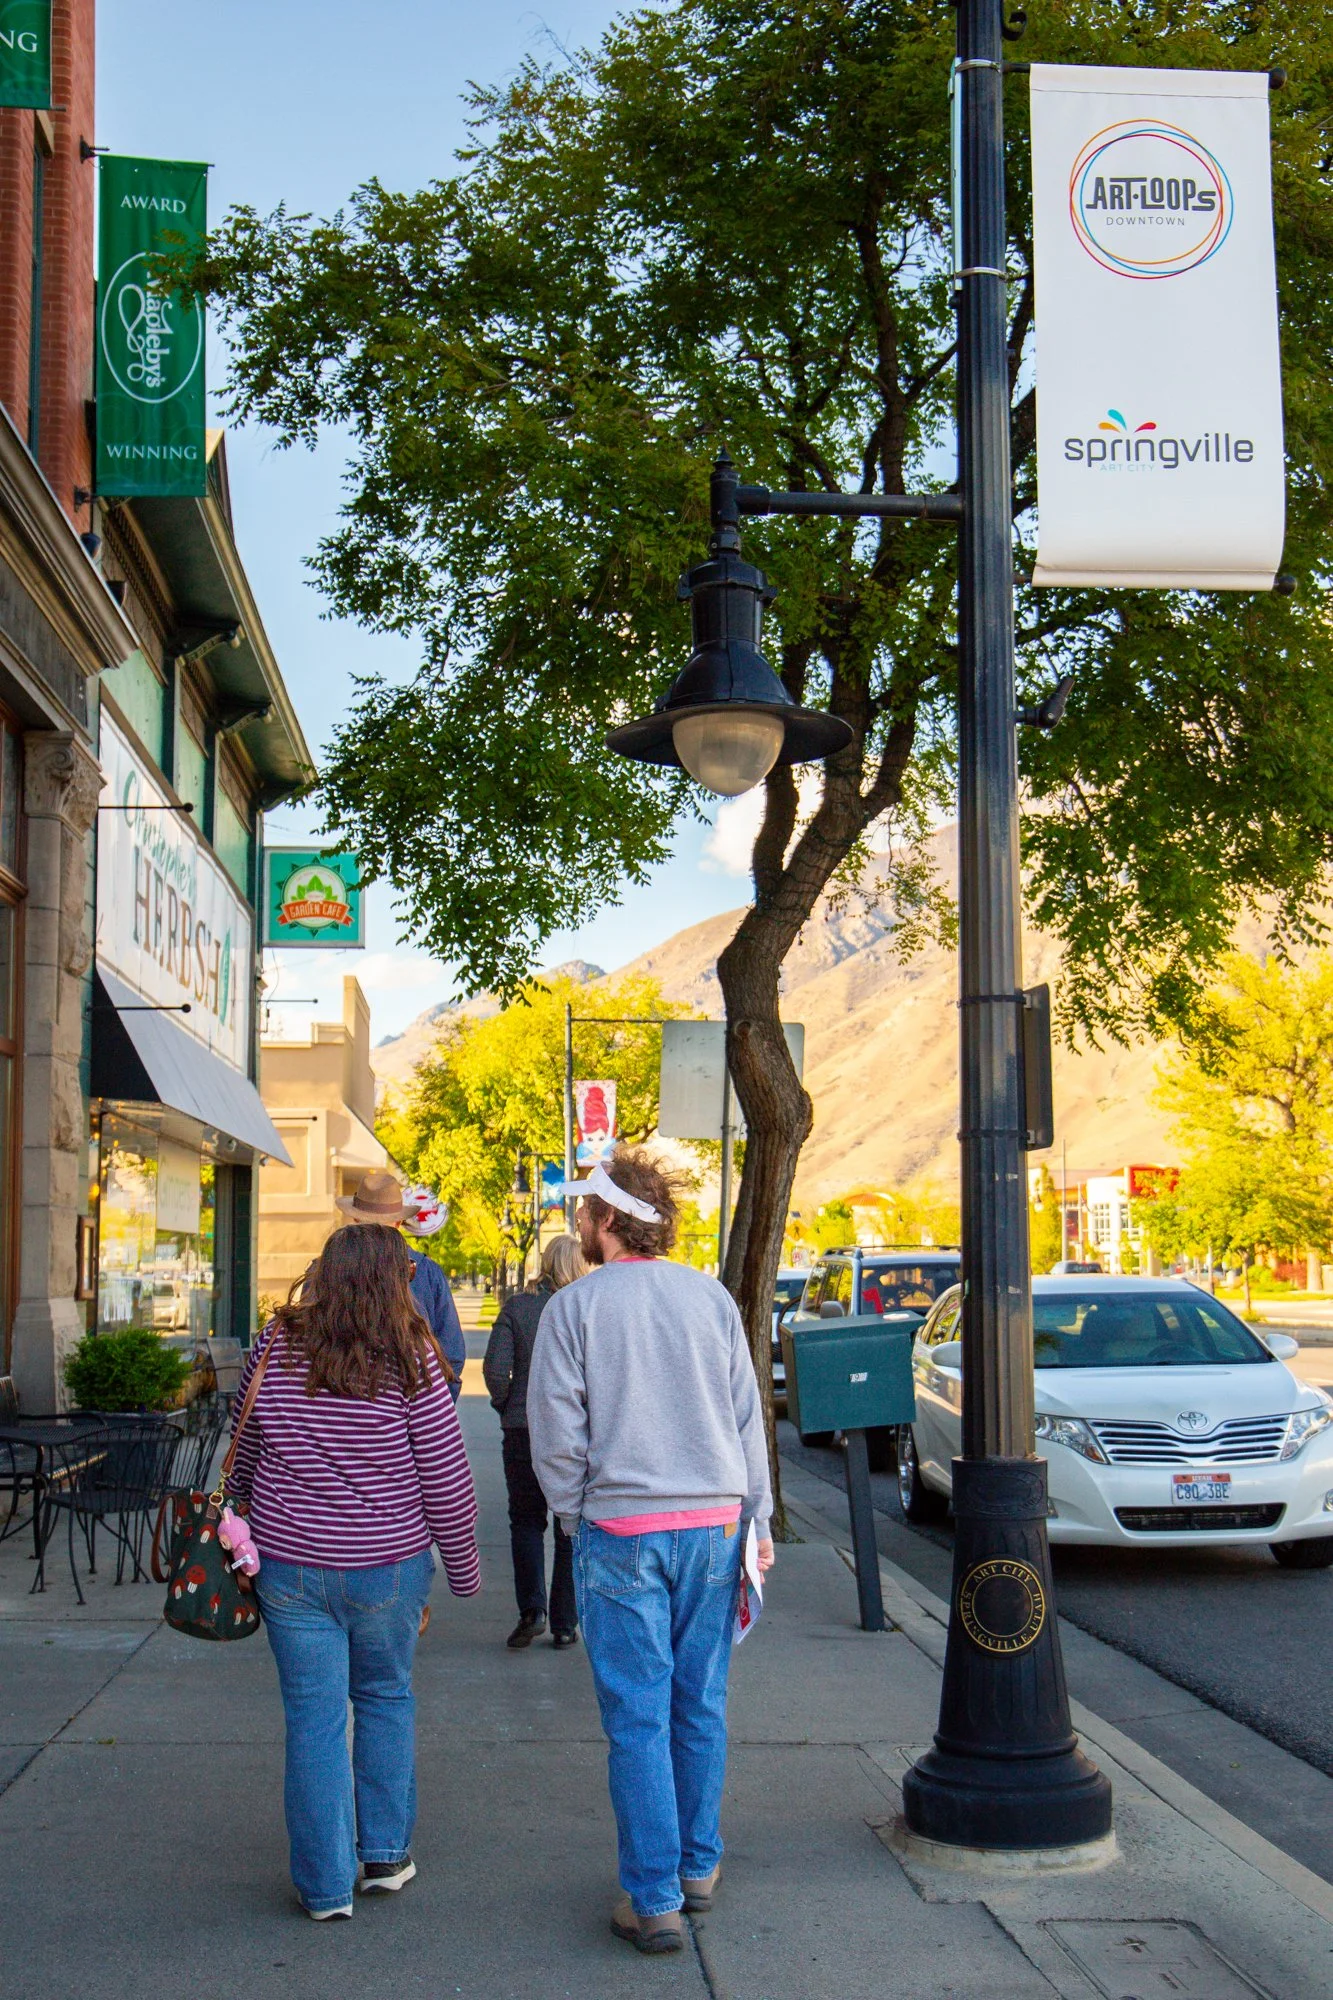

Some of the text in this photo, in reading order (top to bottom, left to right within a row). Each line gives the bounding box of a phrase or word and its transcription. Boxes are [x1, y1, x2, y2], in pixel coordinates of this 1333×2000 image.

[120, 195, 187, 214] AWARD
[1106, 216, 1185, 226] DOWNTOWN
[106, 444, 197, 460] WINNING
[1064, 433, 1254, 469] springville
[1100, 464, 1155, 472] ART CITY
[289, 901, 342, 917] GARDEN CAFE
[973, 1564, 1033, 1583] ART CITY
[1030, 1593, 1042, 1631] UTAH
